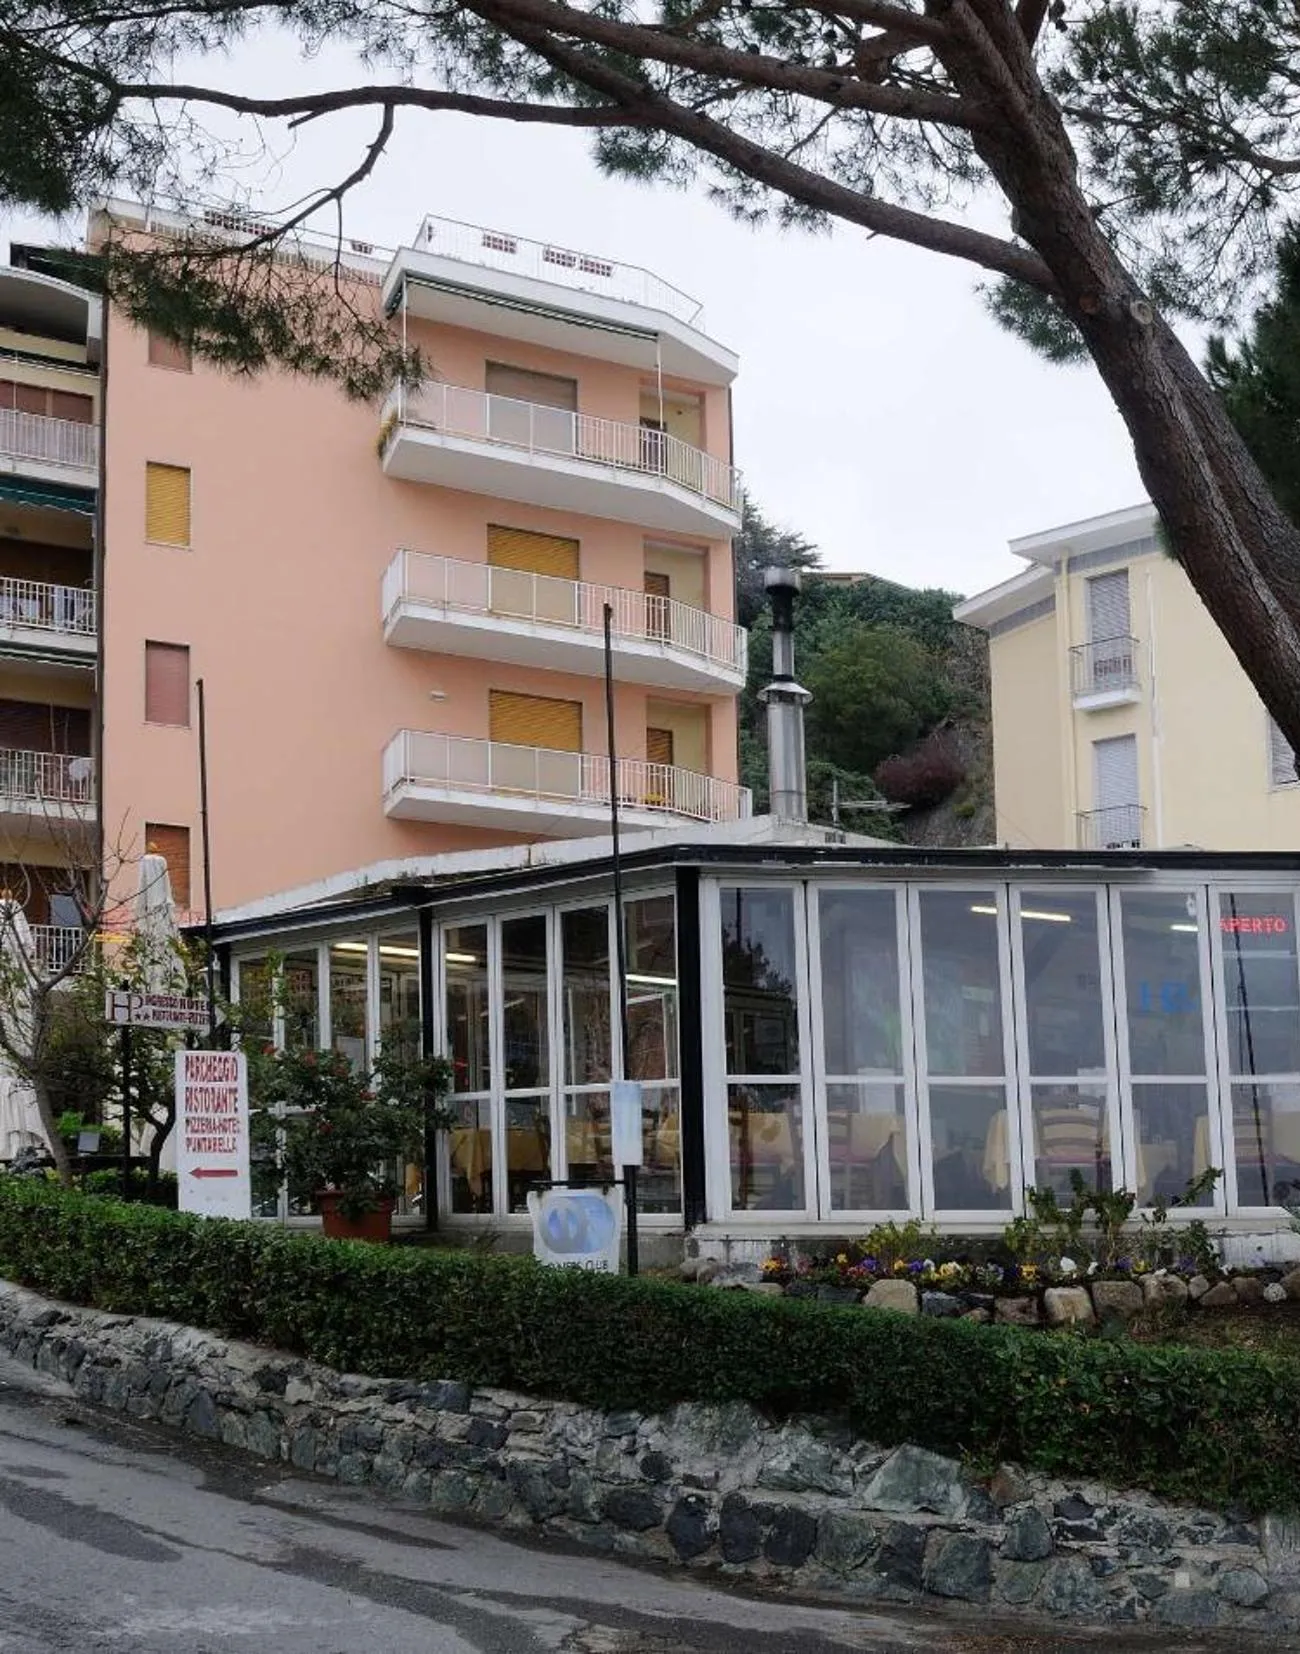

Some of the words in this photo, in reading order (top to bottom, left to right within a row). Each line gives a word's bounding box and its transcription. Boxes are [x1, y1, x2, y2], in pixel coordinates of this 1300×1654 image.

[1220, 916, 1287, 933] APERTO
[185, 1055, 238, 1082] PARCHEGGIO
[185, 1086, 238, 1114] RISTORANTE
